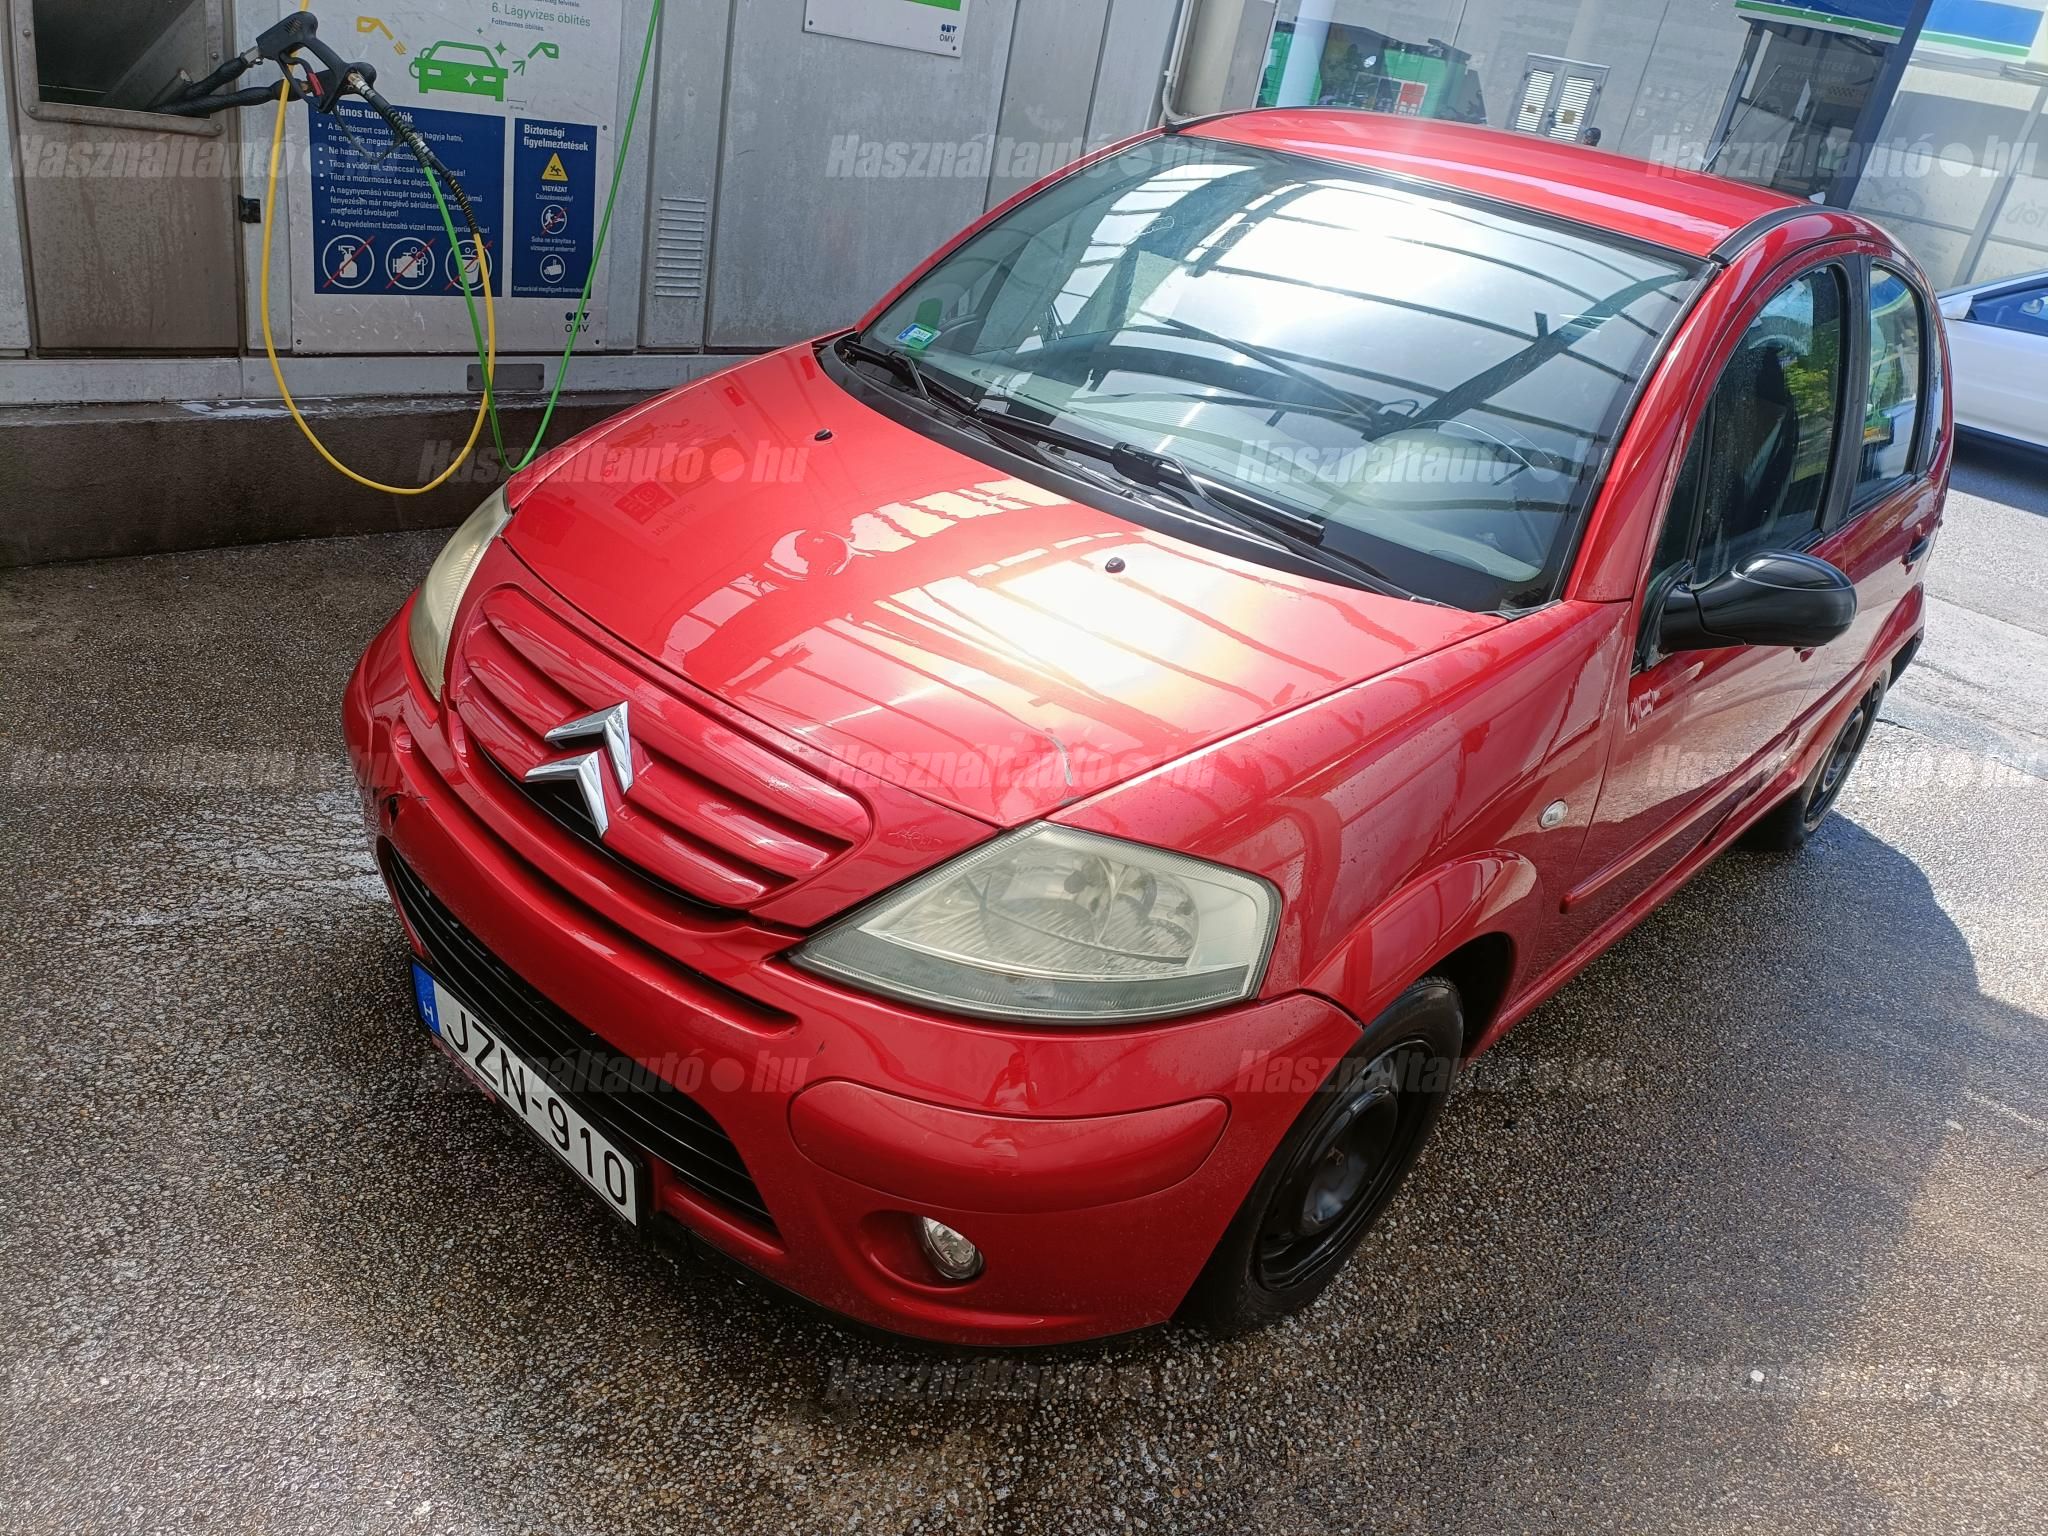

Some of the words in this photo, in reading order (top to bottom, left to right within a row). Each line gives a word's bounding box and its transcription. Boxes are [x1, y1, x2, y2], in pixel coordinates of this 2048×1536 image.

[491, 2, 501, 13] 6.
[504, 3, 555, 21] Lágyvizes
[939, 33, 956, 43] OMV
[328, 122, 334, 131] A
[524, 123, 565, 139] Biztonsági
[523, 136, 589, 151] figyelmeztetések
[328, 146, 339, 155] Ne
[330, 185, 336, 193] A
[331, 219, 337, 227] A
[422, 1000, 435, 1023] H
[446, 1010, 628, 1206] JZN-910
